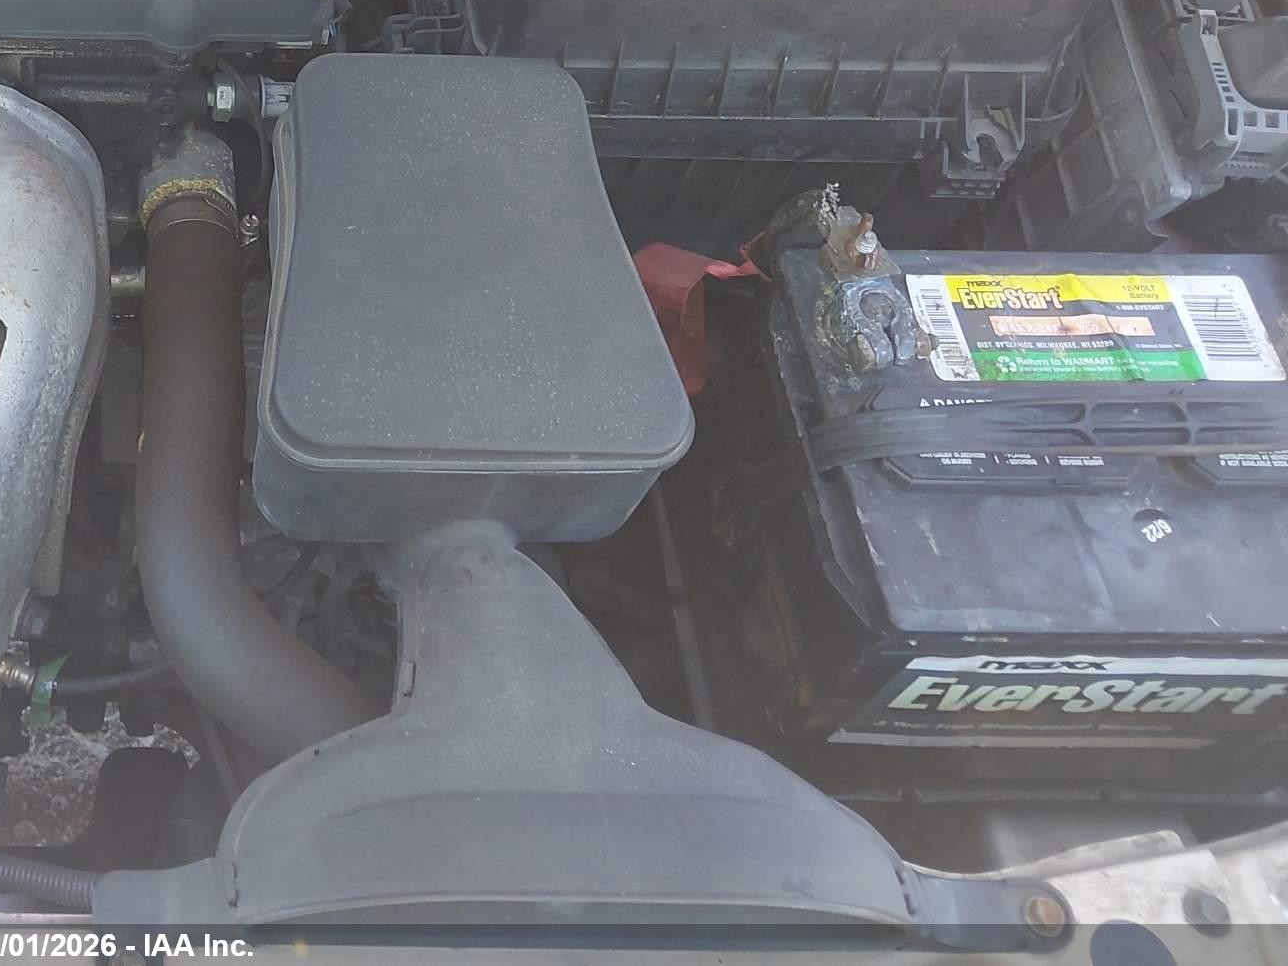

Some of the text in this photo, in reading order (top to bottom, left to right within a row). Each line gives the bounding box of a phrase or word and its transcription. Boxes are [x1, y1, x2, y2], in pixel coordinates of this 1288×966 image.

[957, 287, 1064, 310] EverStart
[1129, 292, 1160, 300] Battery
[1051, 356, 1061, 365] to
[978, 658, 1111, 672] maxx
[888, 675, 1288, 715] EverStart
